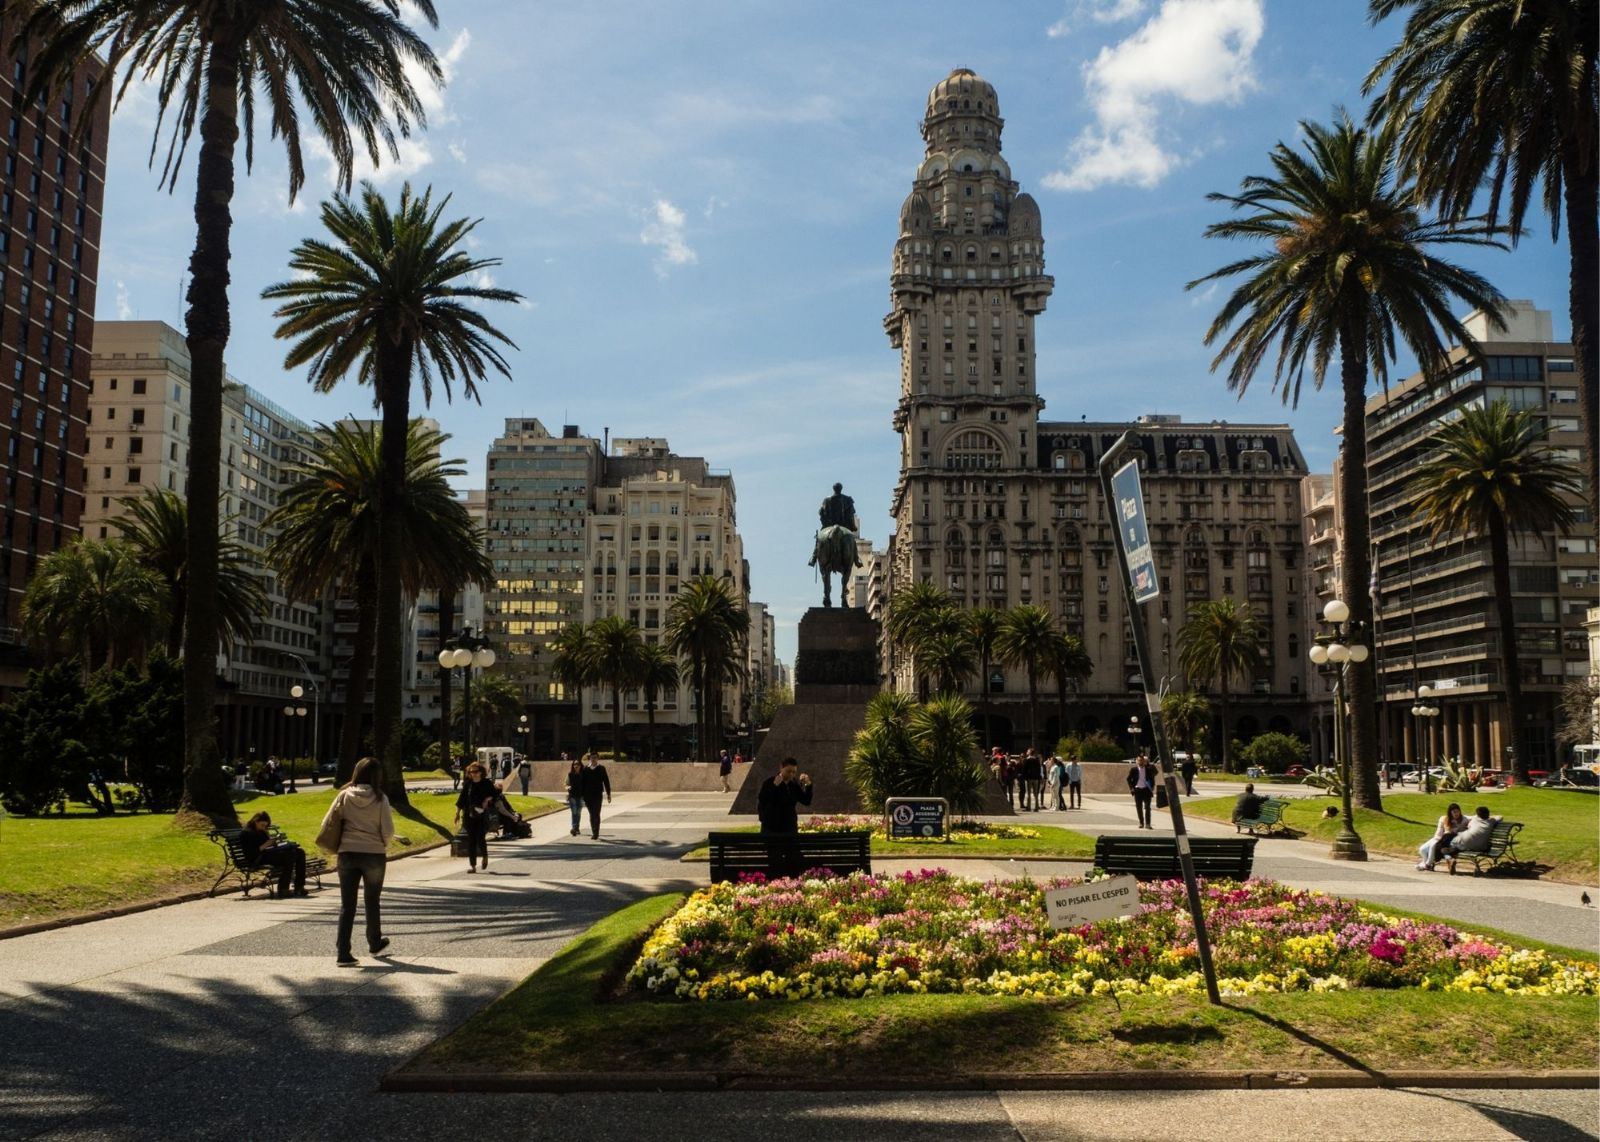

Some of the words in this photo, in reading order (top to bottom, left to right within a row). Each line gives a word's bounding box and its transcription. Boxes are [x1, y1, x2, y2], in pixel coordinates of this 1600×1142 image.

[1056, 900, 1067, 908] NO
[1068, 895, 1090, 906] PISAR
[1092, 893, 1101, 902] EL
[1102, 887, 1129, 899] CESPED
